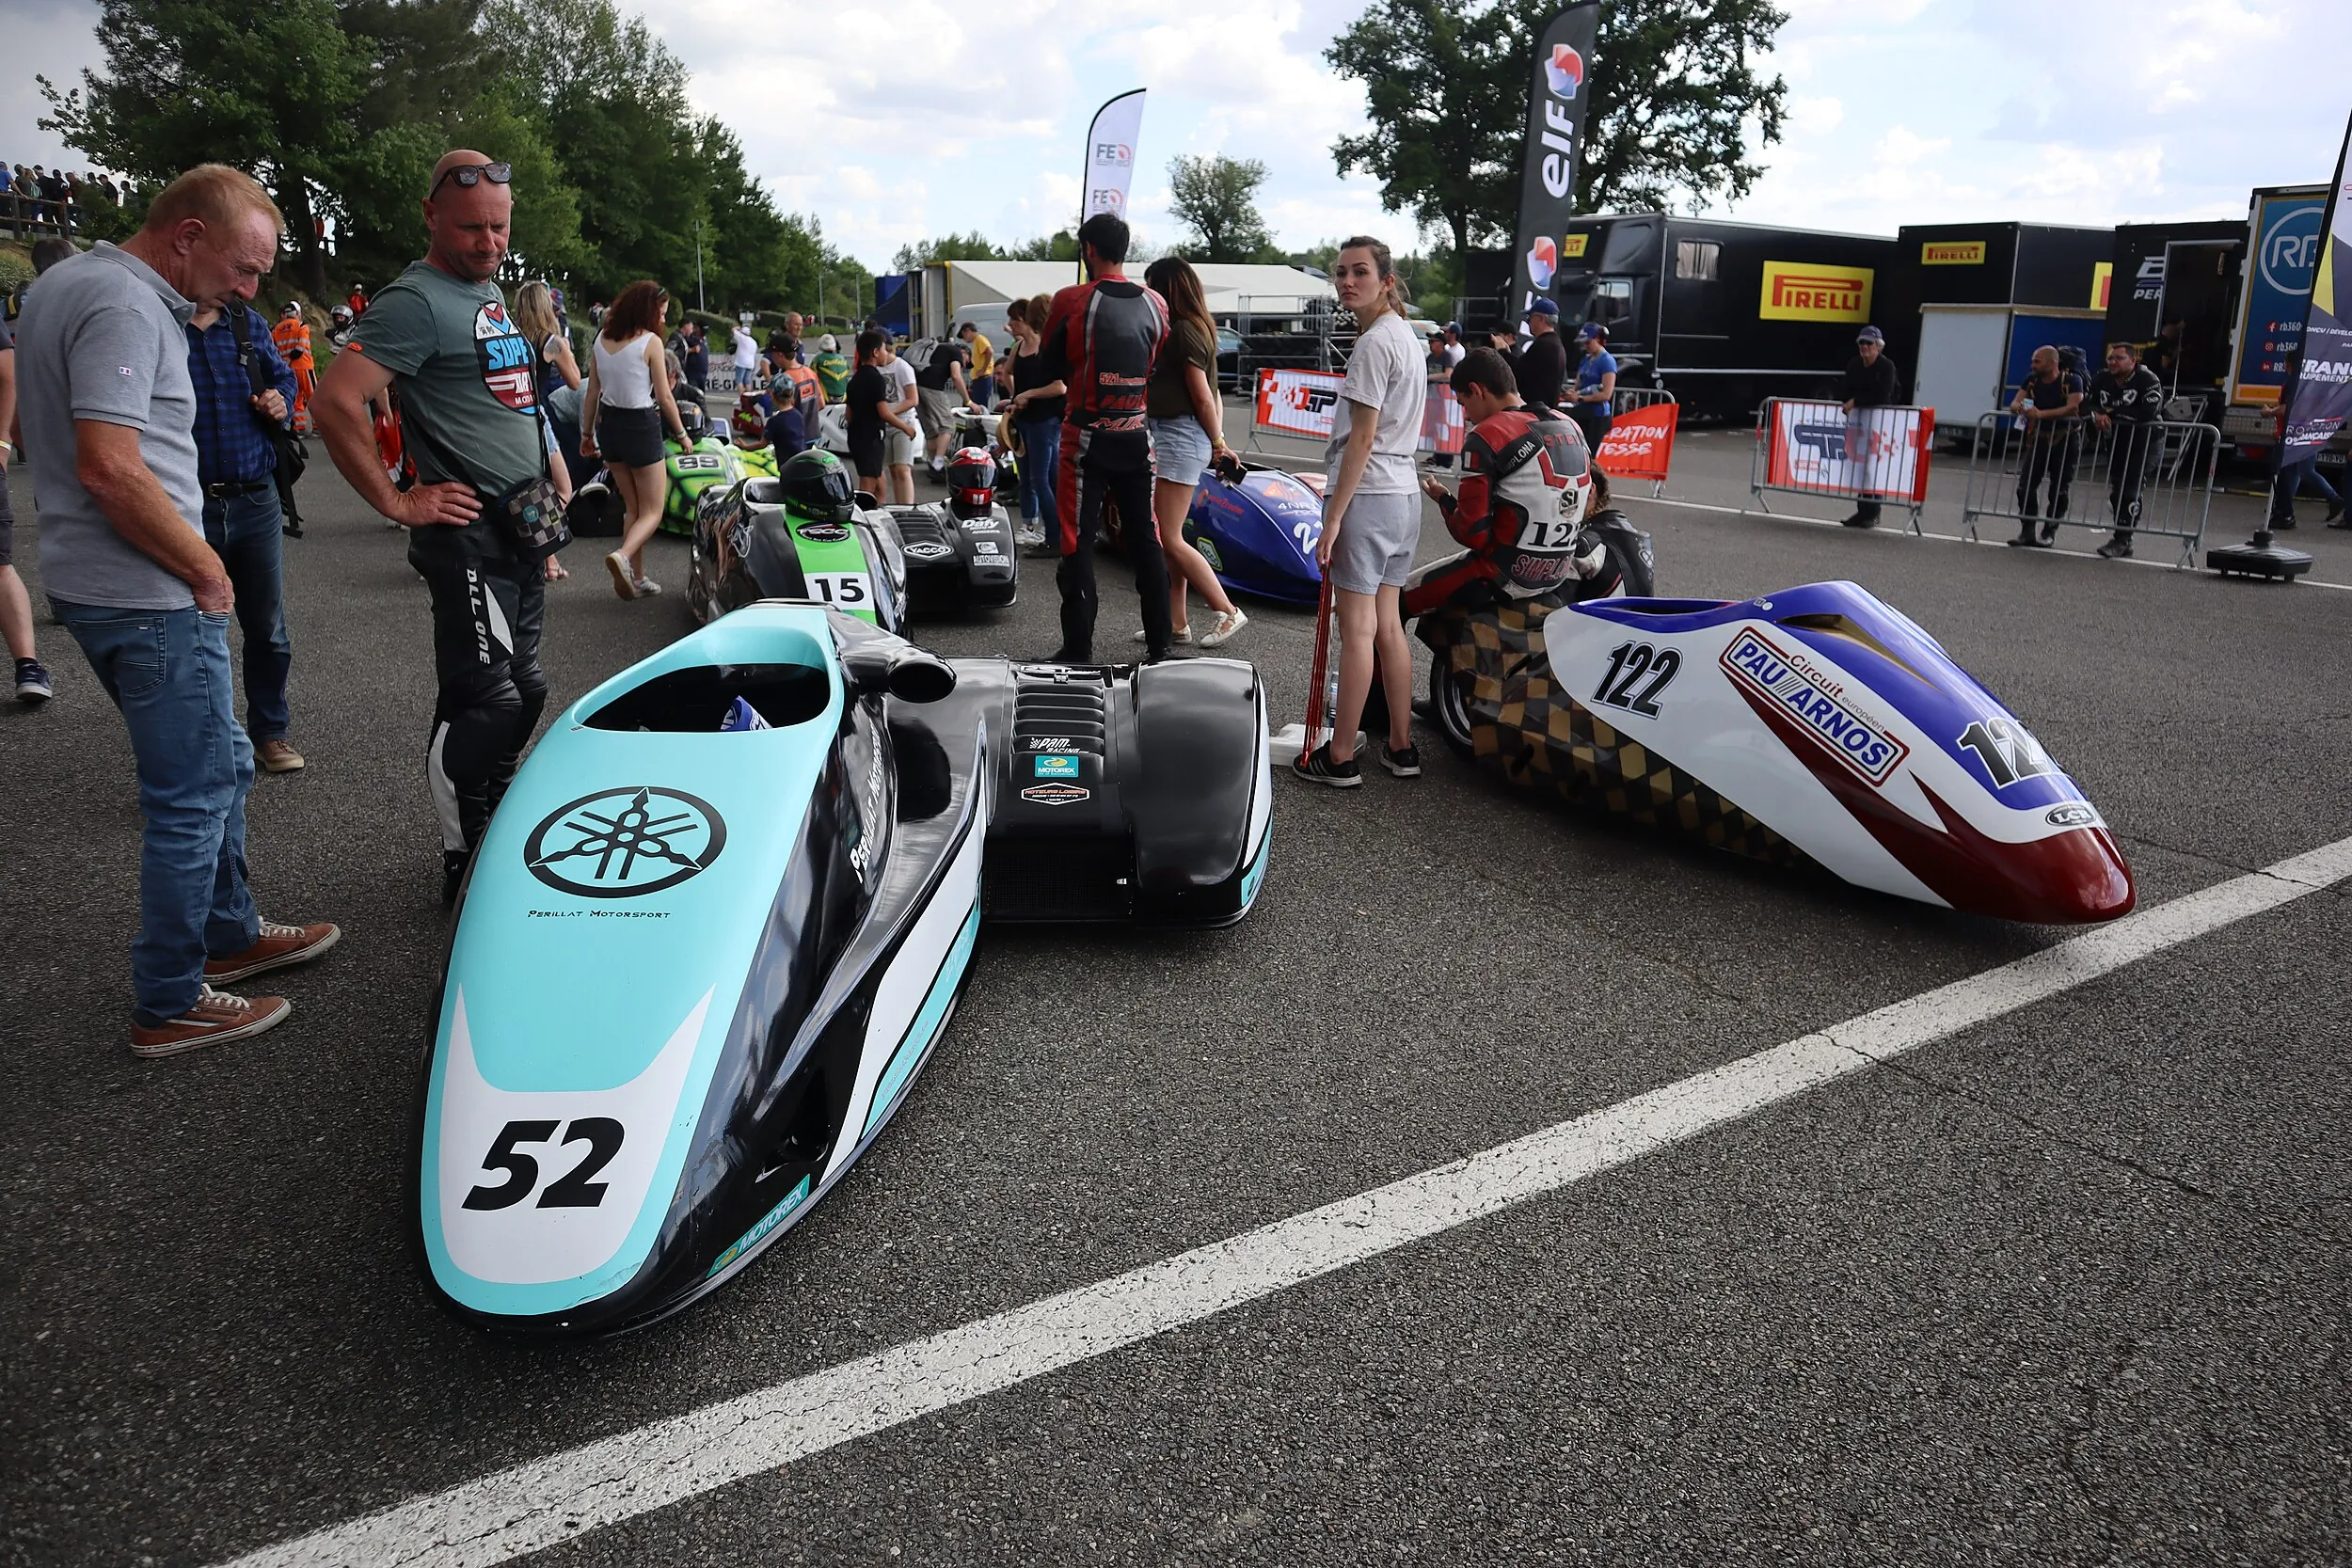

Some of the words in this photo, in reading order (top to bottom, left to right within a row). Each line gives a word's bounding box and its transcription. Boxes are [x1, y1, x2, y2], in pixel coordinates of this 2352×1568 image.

[1540, 99, 1575, 199] elf
[1927, 245, 1979, 261] PIRELLI
[1772, 274, 1864, 311] PIRELLI
[815, 578, 865, 602] 15
[1590, 640, 1683, 721] 122
[1789, 654, 1844, 698] Circuit
[1841, 695, 1885, 731] européen
[461, 1117, 625, 1211] 52
[738, 1182, 804, 1254] MOTOREX
